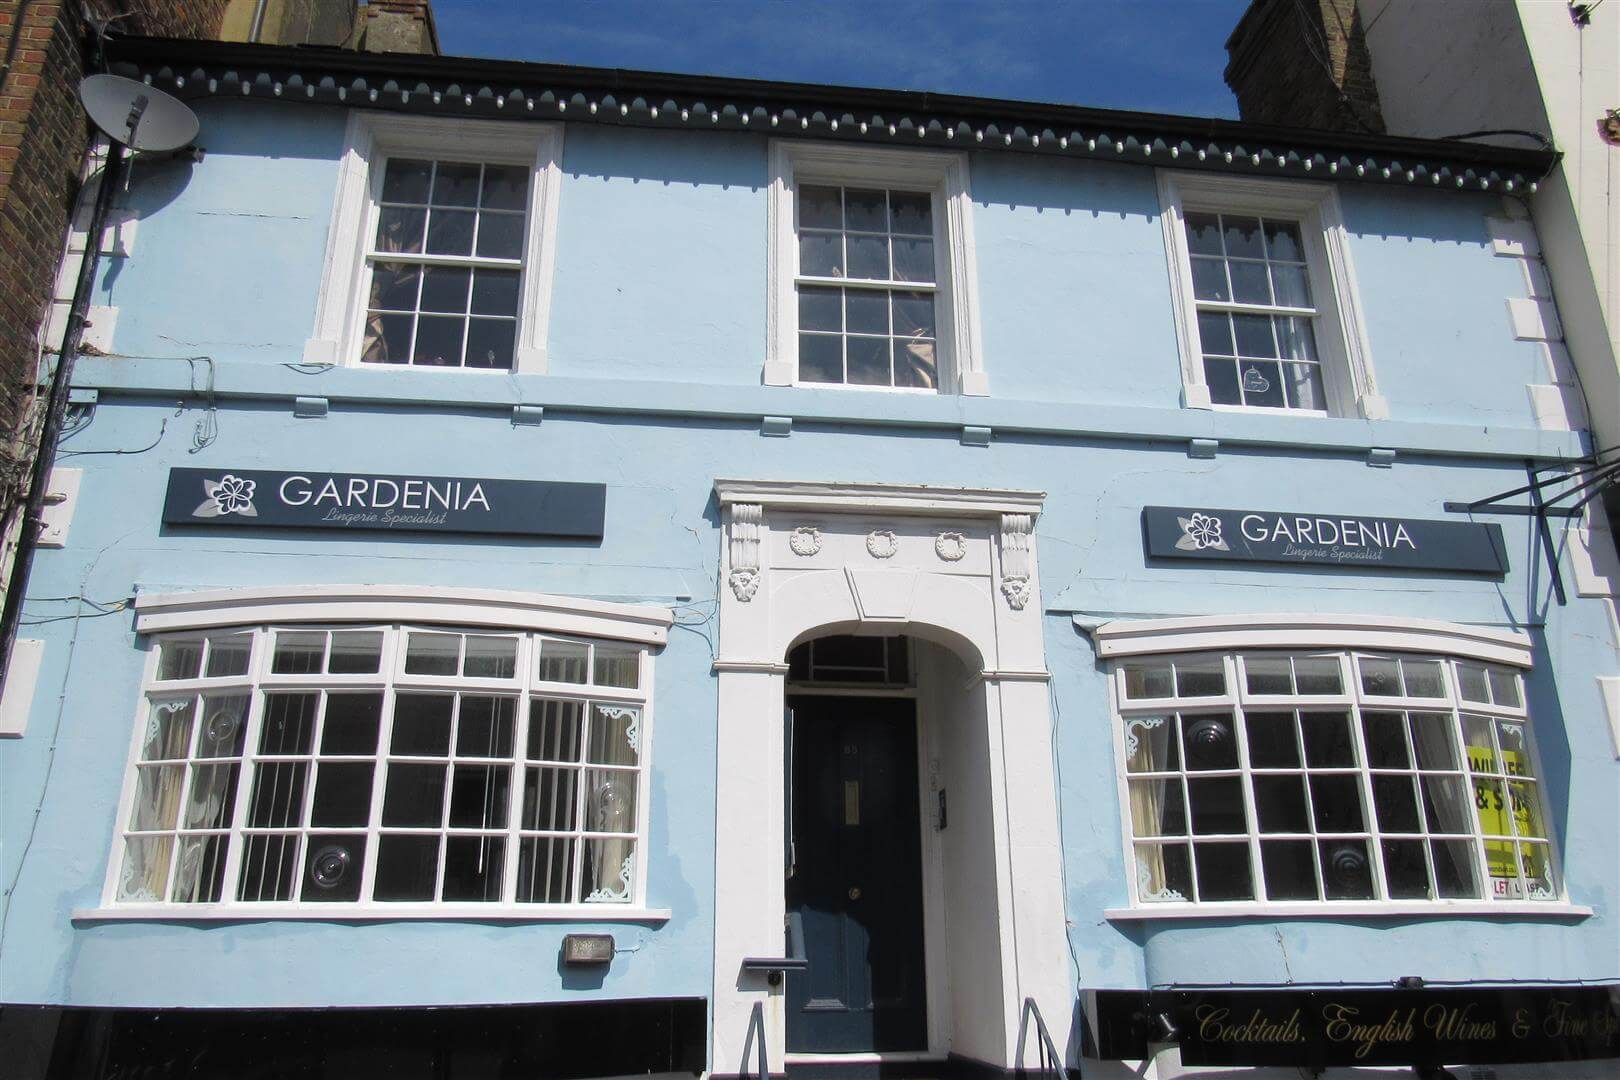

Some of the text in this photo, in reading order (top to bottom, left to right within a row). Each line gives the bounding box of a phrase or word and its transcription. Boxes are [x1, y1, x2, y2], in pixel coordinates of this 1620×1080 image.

[279, 475, 491, 512] GARDENIA
[322, 507, 447, 528] Lingerie Specialist
[1240, 514, 1416, 549] GARDENIA
[1282, 543, 1383, 562] Lingerie Specialist
[1475, 786, 1488, 810] &
[1494, 881, 1508, 896] LET
[1323, 1003, 1416, 1058] English
[1424, 1003, 1496, 1041] Wines
[1512, 1008, 1531, 1039] &
